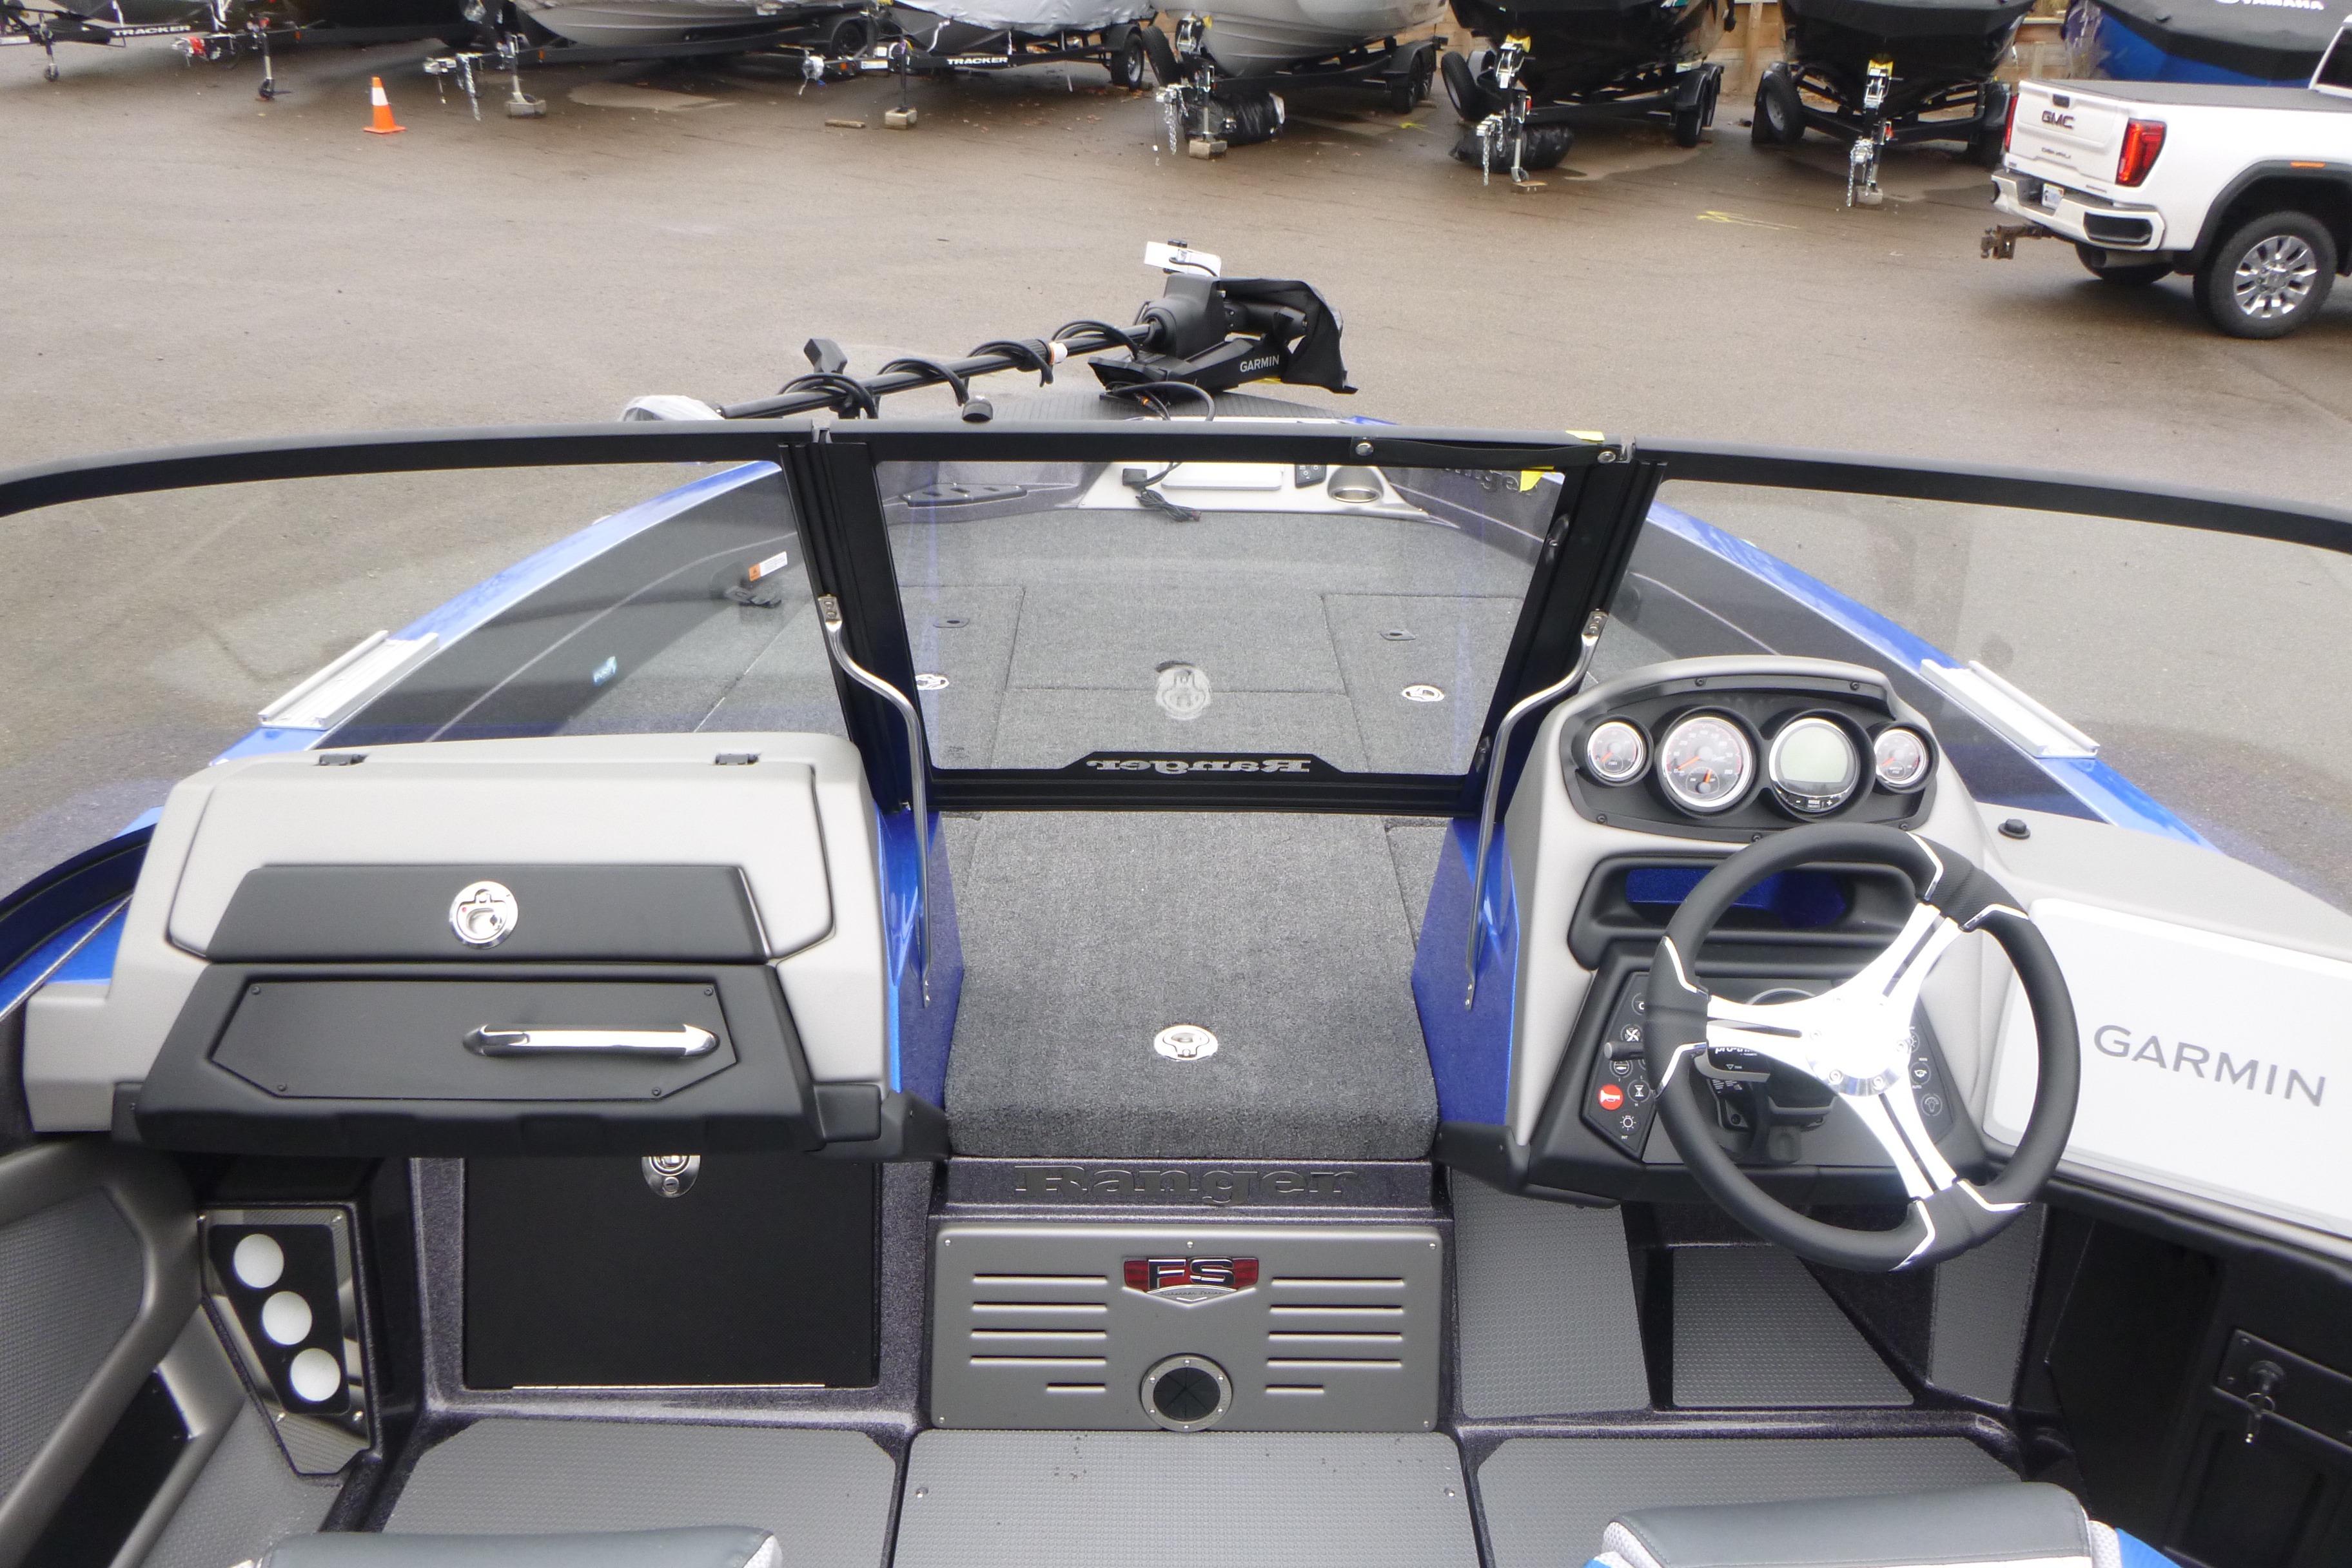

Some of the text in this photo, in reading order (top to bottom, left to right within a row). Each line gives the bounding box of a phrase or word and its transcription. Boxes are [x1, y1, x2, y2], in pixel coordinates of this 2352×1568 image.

[113, 26, 190, 35] TRACKER
[2042, 110, 2074, 129] GMC
[1240, 355, 1279, 373] GARMIN
[2093, 1024, 2326, 1107] GARMIN
[1014, 1166, 1357, 1204] Ranger
[1148, 1258, 1235, 1289] FS
